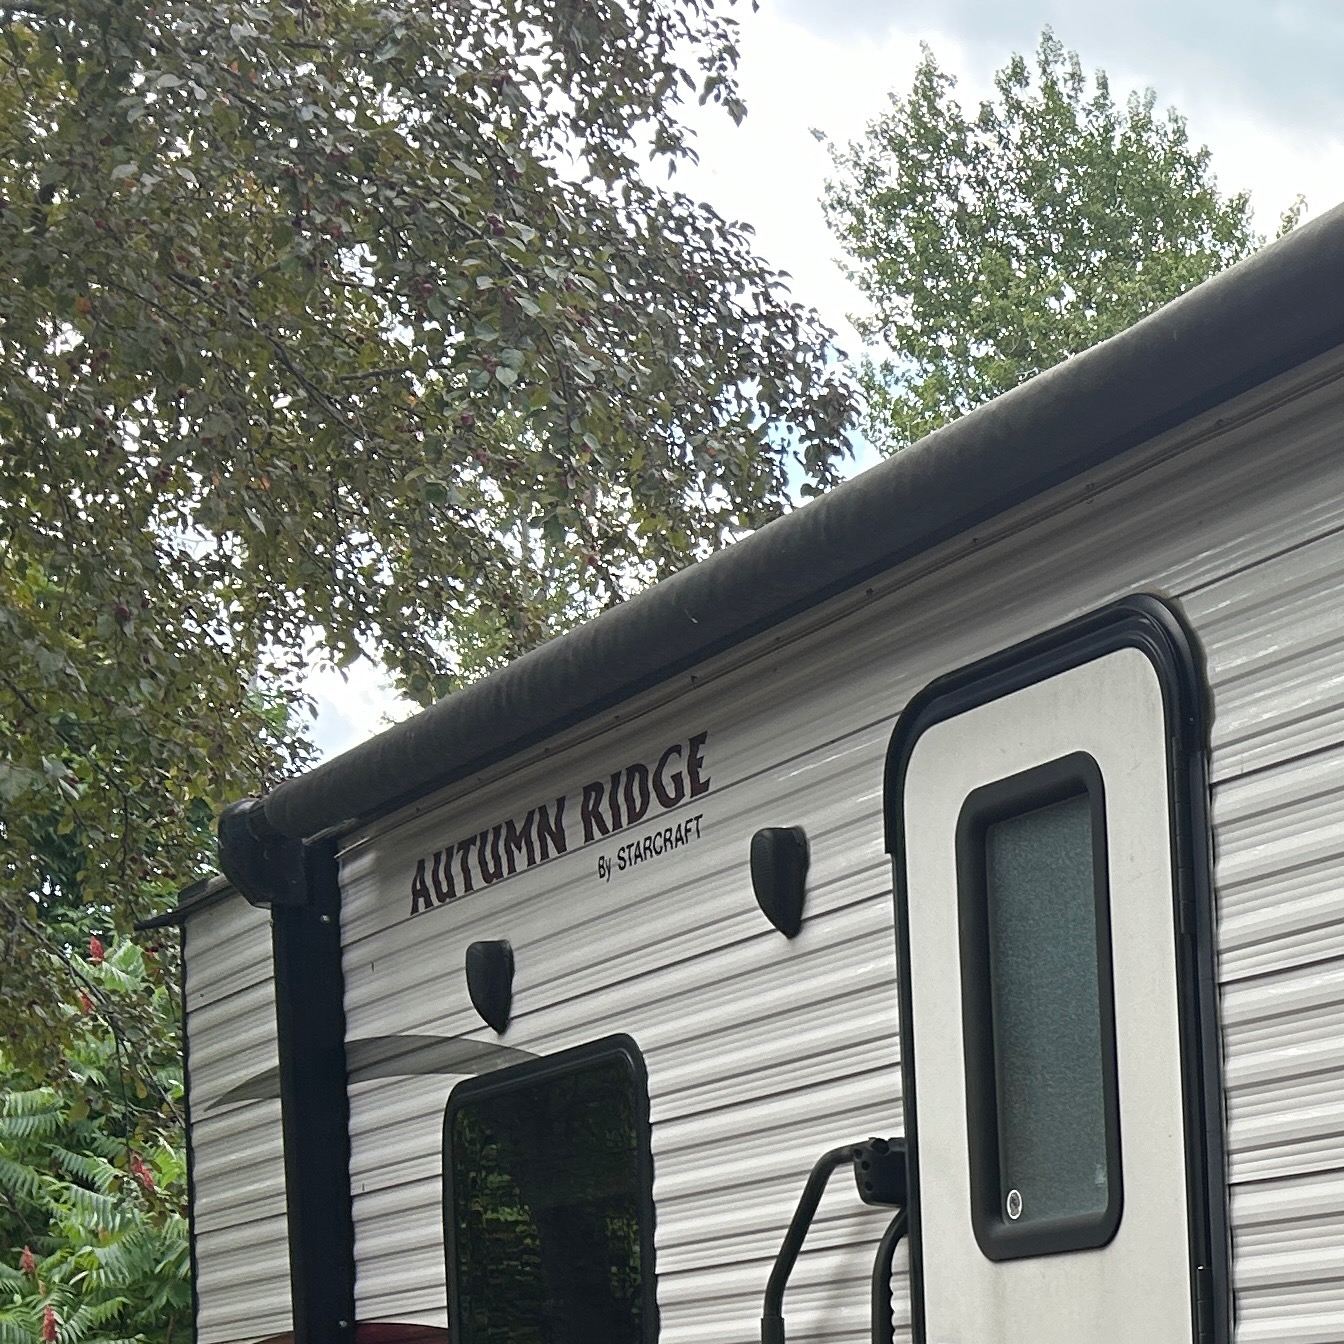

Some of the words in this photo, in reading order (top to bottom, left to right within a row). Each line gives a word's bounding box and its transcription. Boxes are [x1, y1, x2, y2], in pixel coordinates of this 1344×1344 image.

[409, 795, 568, 917] AUTUMN
[579, 730, 711, 844] RIDGE
[598, 855, 612, 882] By
[617, 813, 704, 872] STARCRAFT
